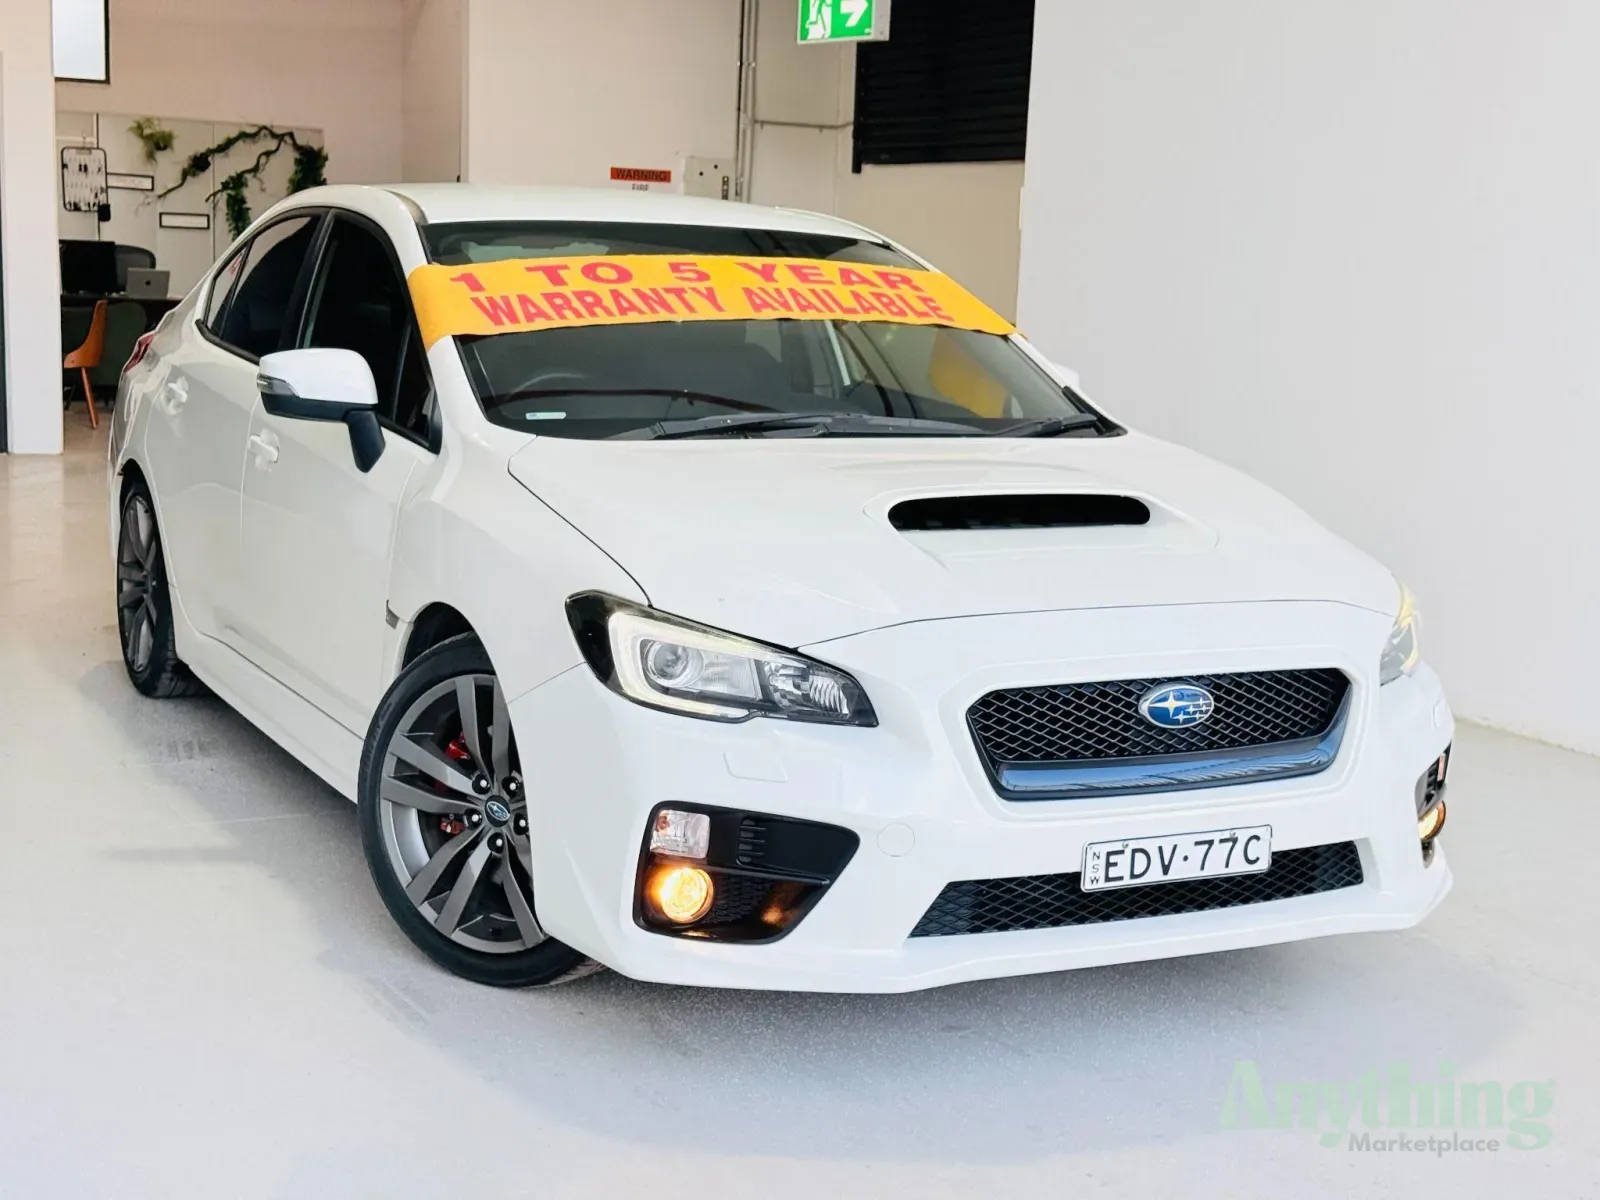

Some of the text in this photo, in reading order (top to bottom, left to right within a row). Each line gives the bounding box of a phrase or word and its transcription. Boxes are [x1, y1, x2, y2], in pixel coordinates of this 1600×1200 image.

[615, 167, 667, 182] WARNING
[450, 262, 926, 293] 1 TO 5 YEAR
[470, 286, 955, 327] WARRANTY AVAILABLE
[1089, 850, 1101, 886] NSW
